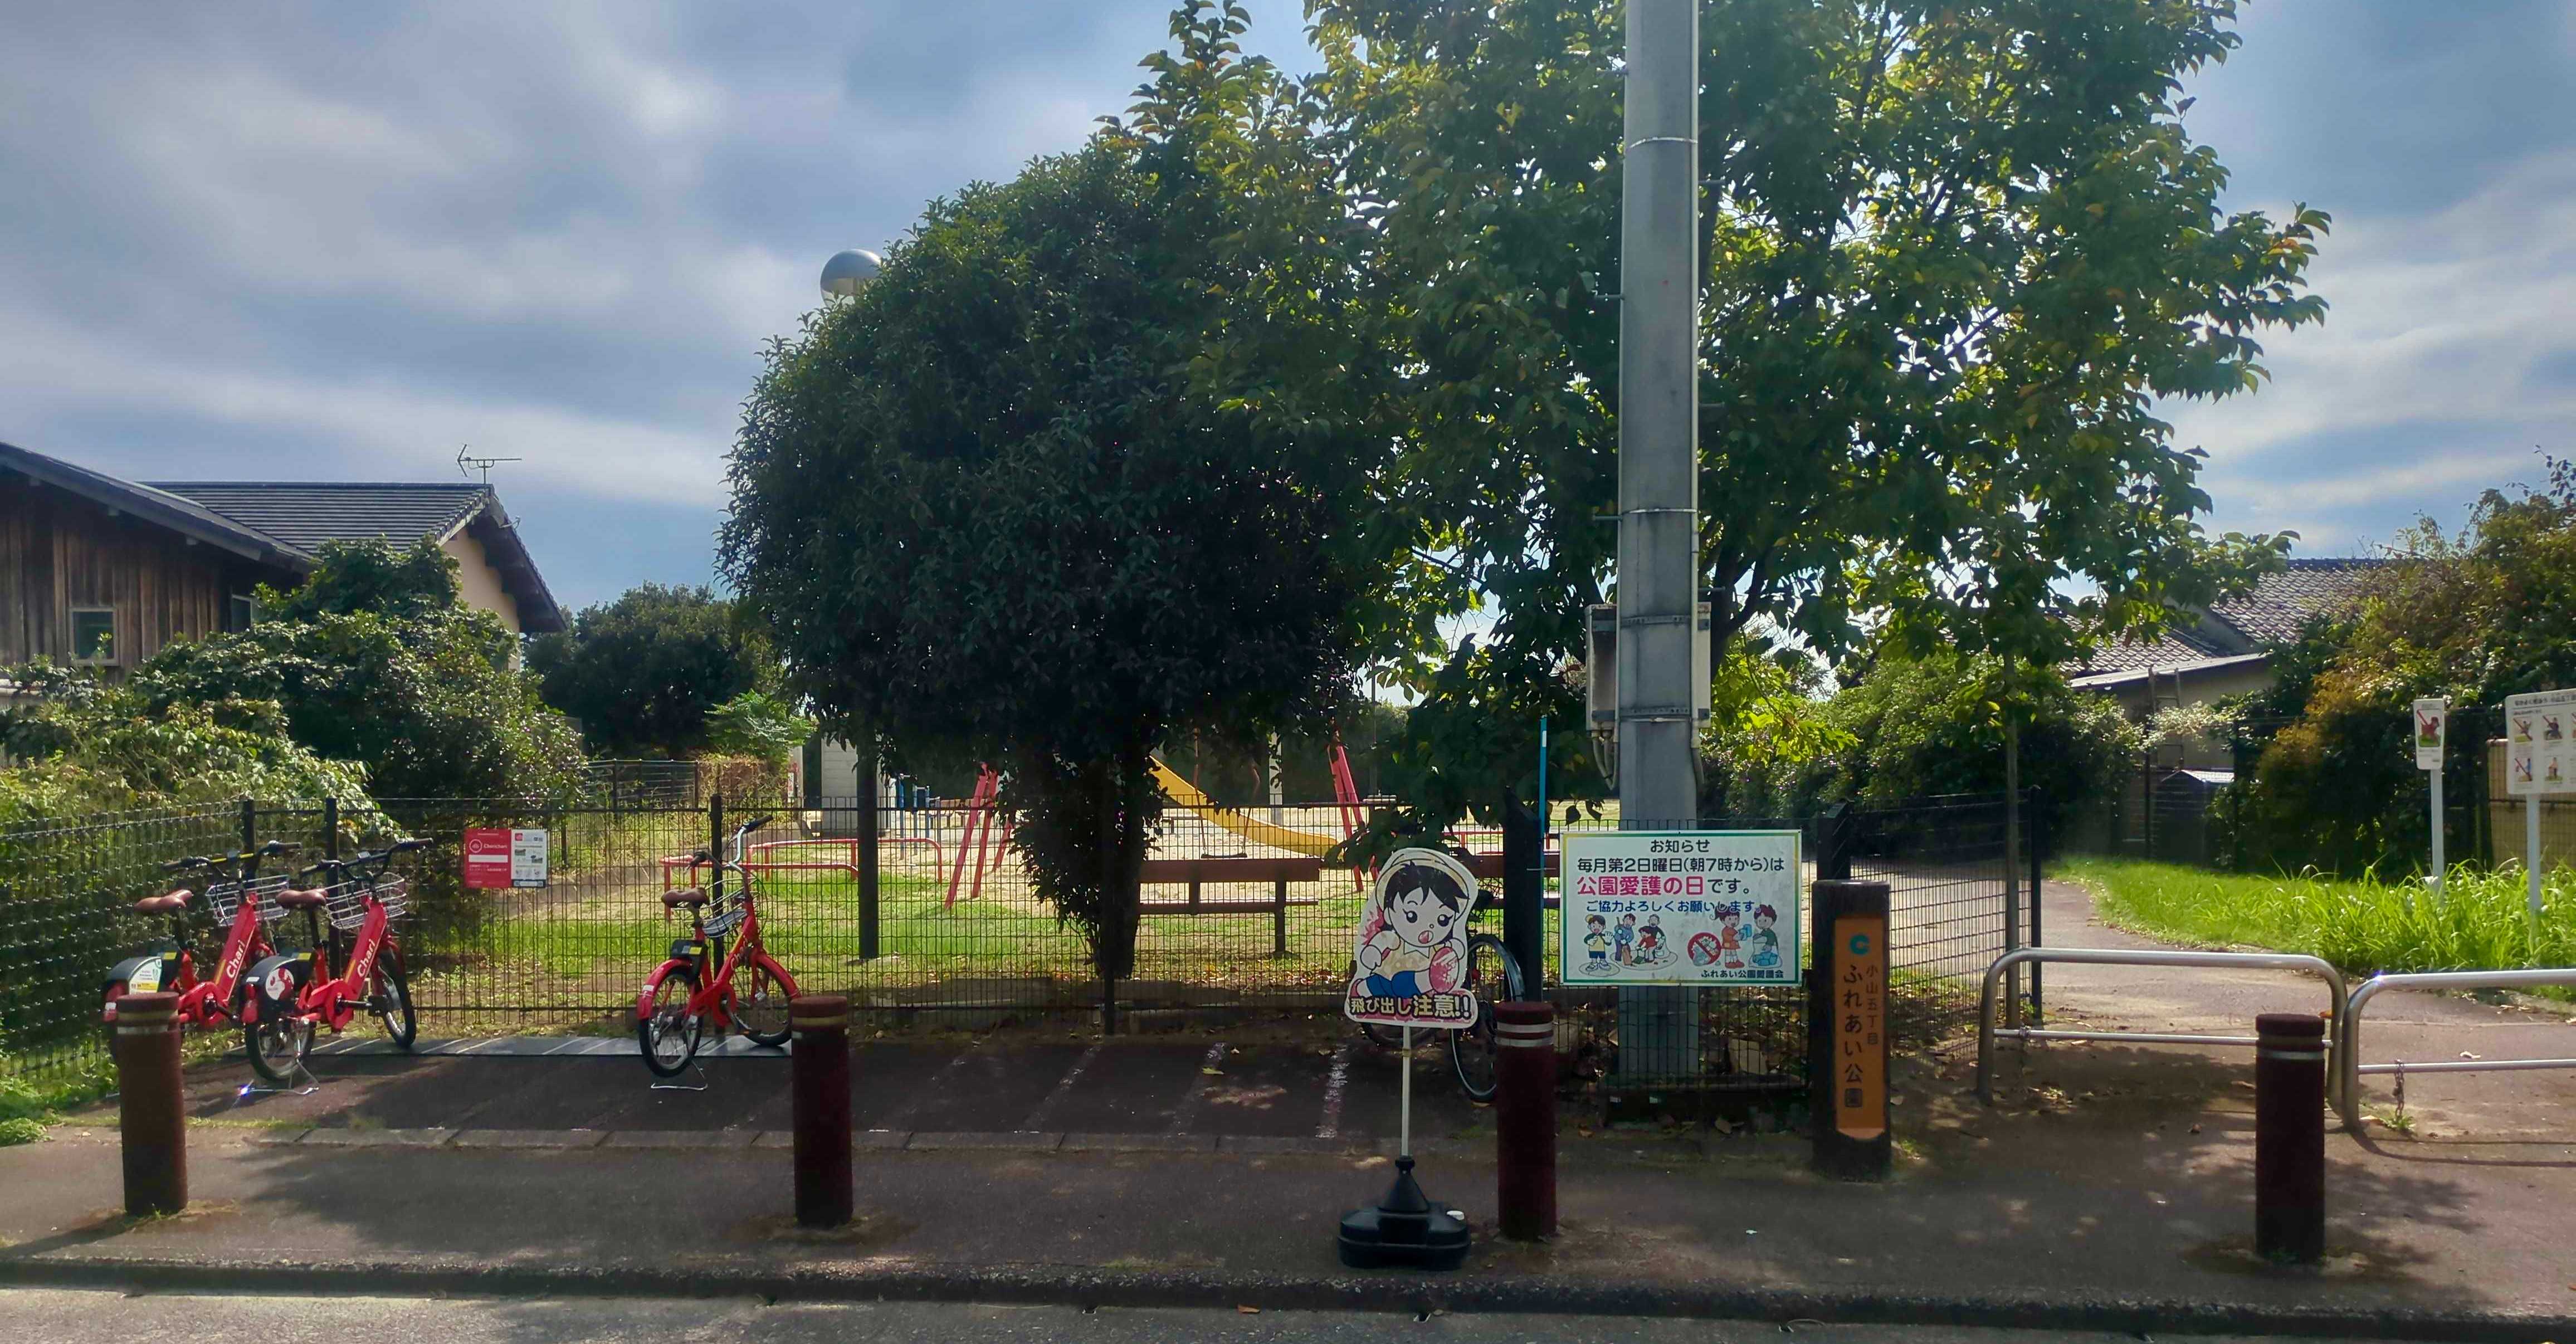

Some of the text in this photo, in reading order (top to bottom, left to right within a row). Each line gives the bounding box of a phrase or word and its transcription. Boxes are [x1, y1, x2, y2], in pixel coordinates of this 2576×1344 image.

[1650, 839, 1710, 853] お知らせ
[1577, 857, 1784, 872] 毎月第2日曜日(朝7時から)は
[1577, 876, 1750, 896] 公園愛護の日です。
[226, 940, 245, 978] Chari
[357, 939, 375, 978] Chari
[1866, 965, 1879, 1045] 小山五丁目
